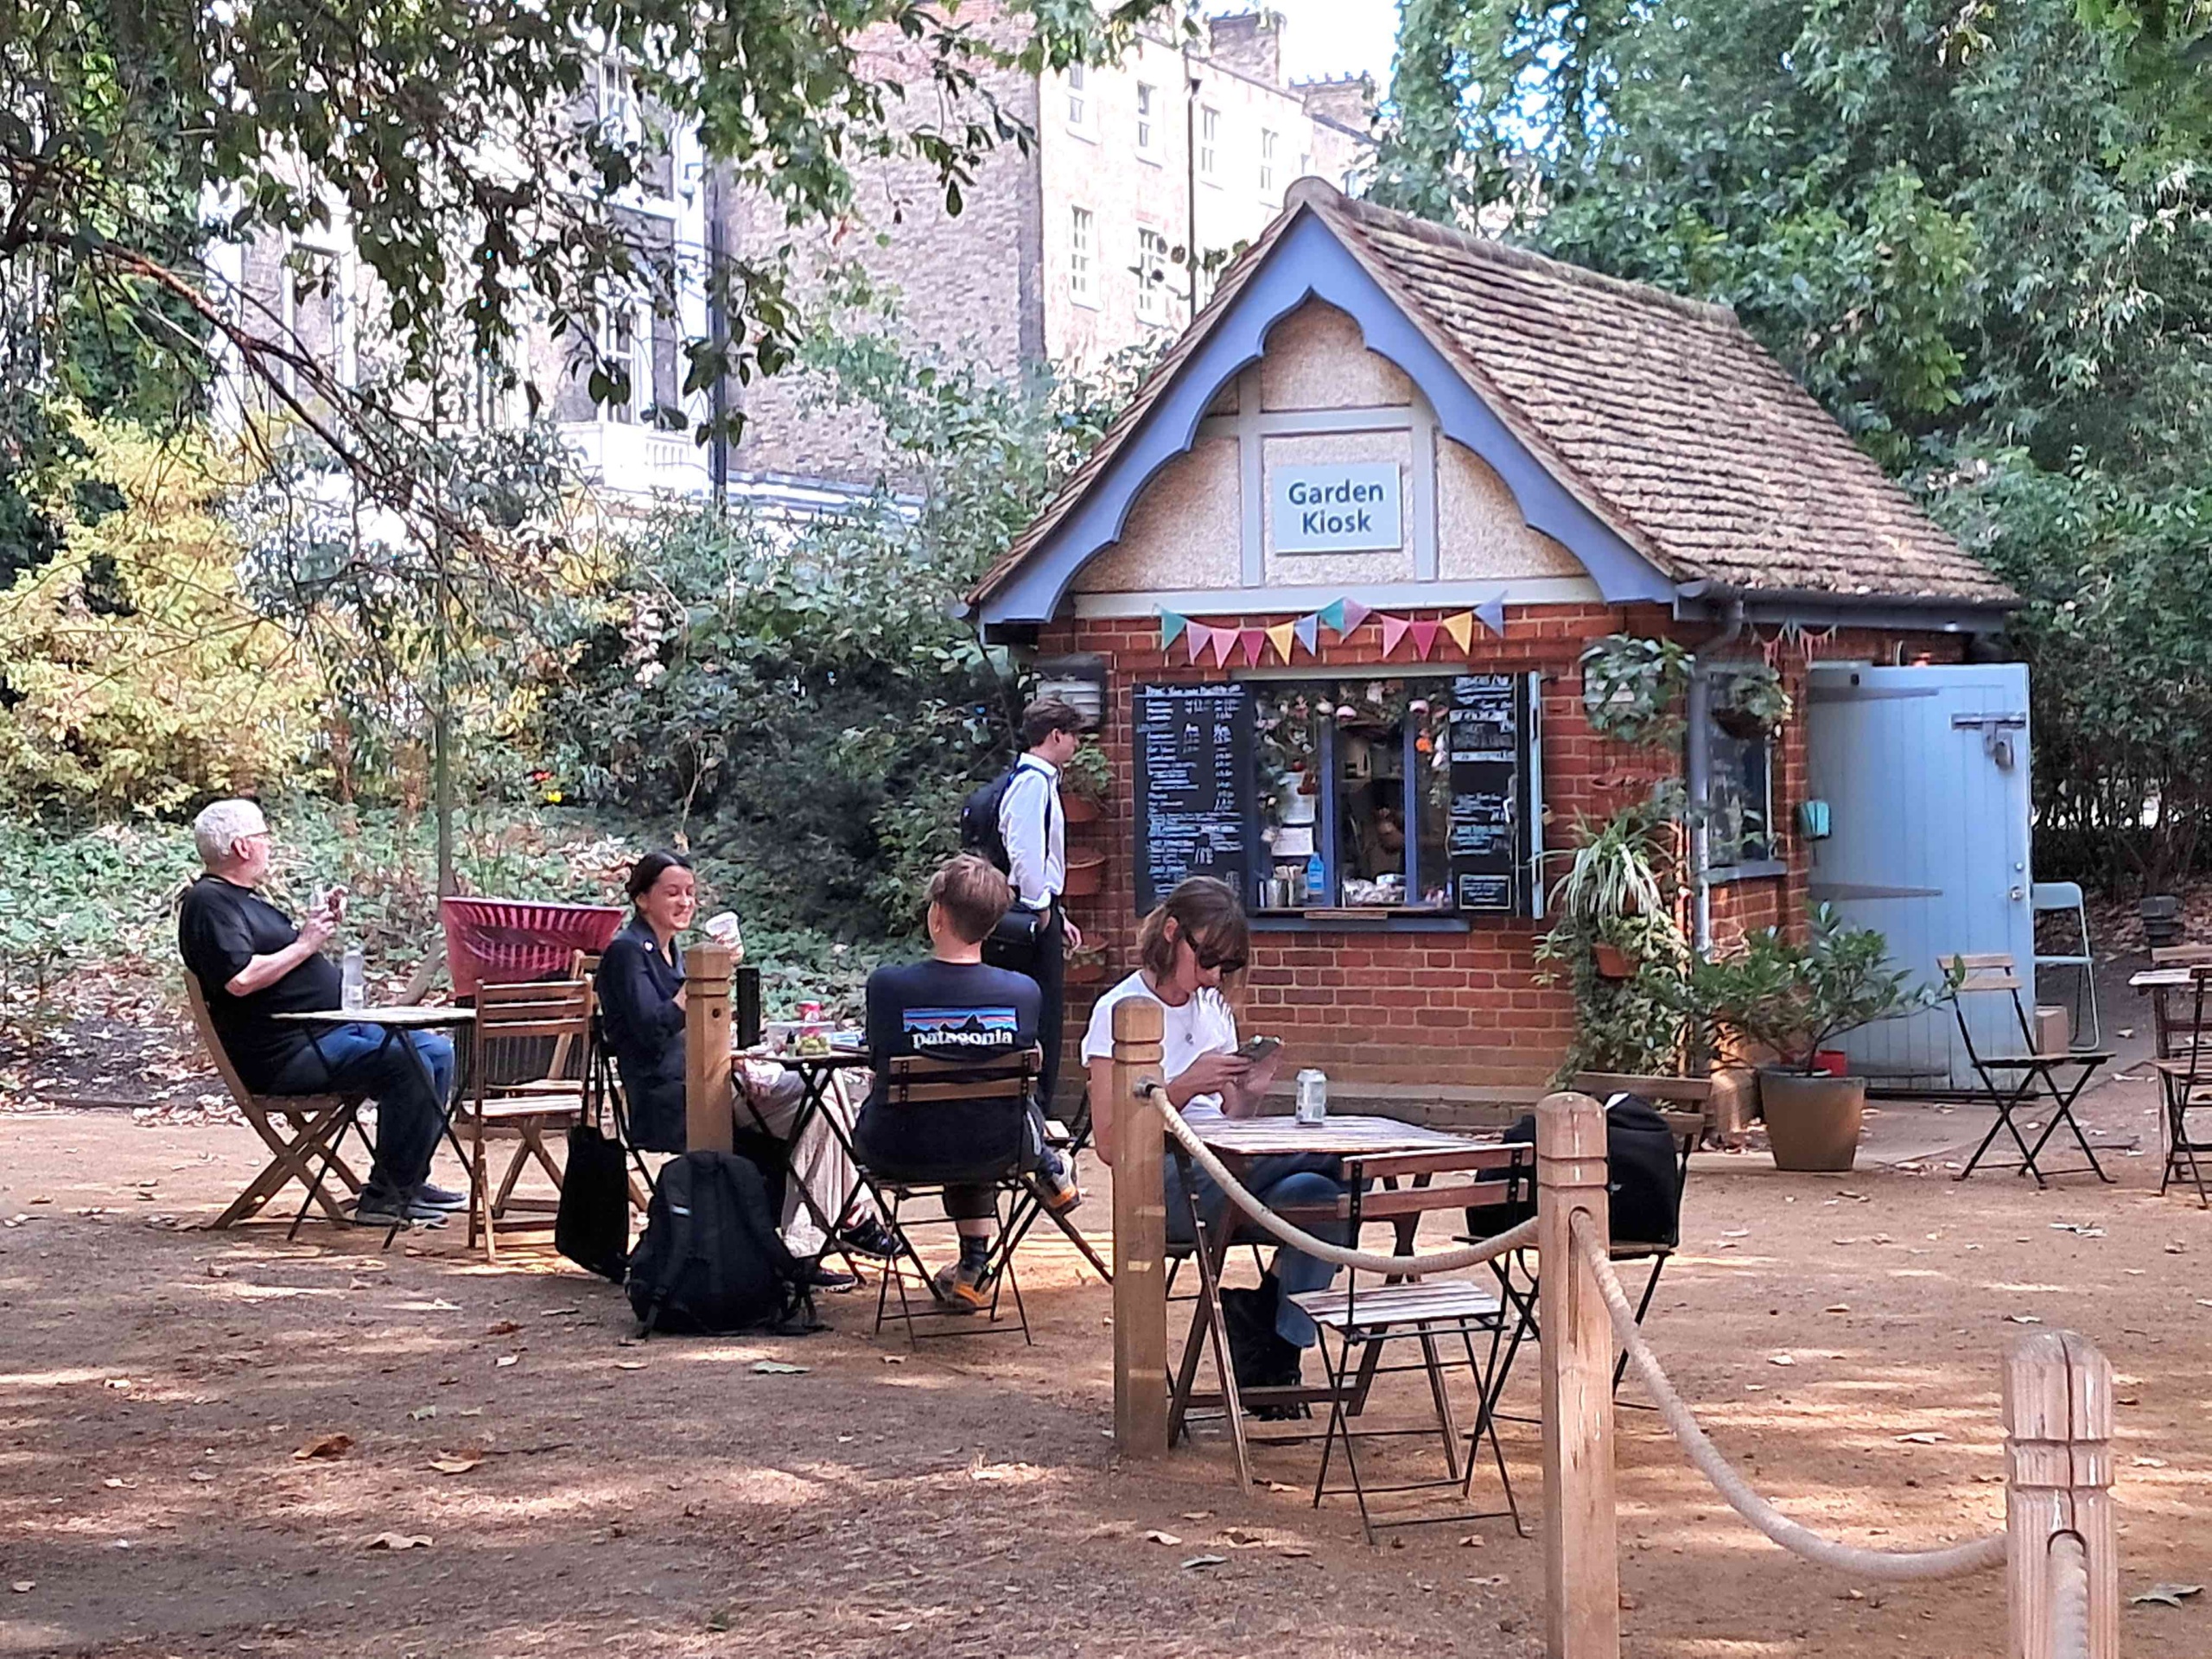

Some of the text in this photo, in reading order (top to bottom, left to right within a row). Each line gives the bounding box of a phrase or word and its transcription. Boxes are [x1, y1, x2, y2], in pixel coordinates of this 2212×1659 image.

[1288, 479, 1384, 505] Garden
[1302, 508, 1372, 535] Kiosk
[912, 1029, 1014, 1050] patagonia
